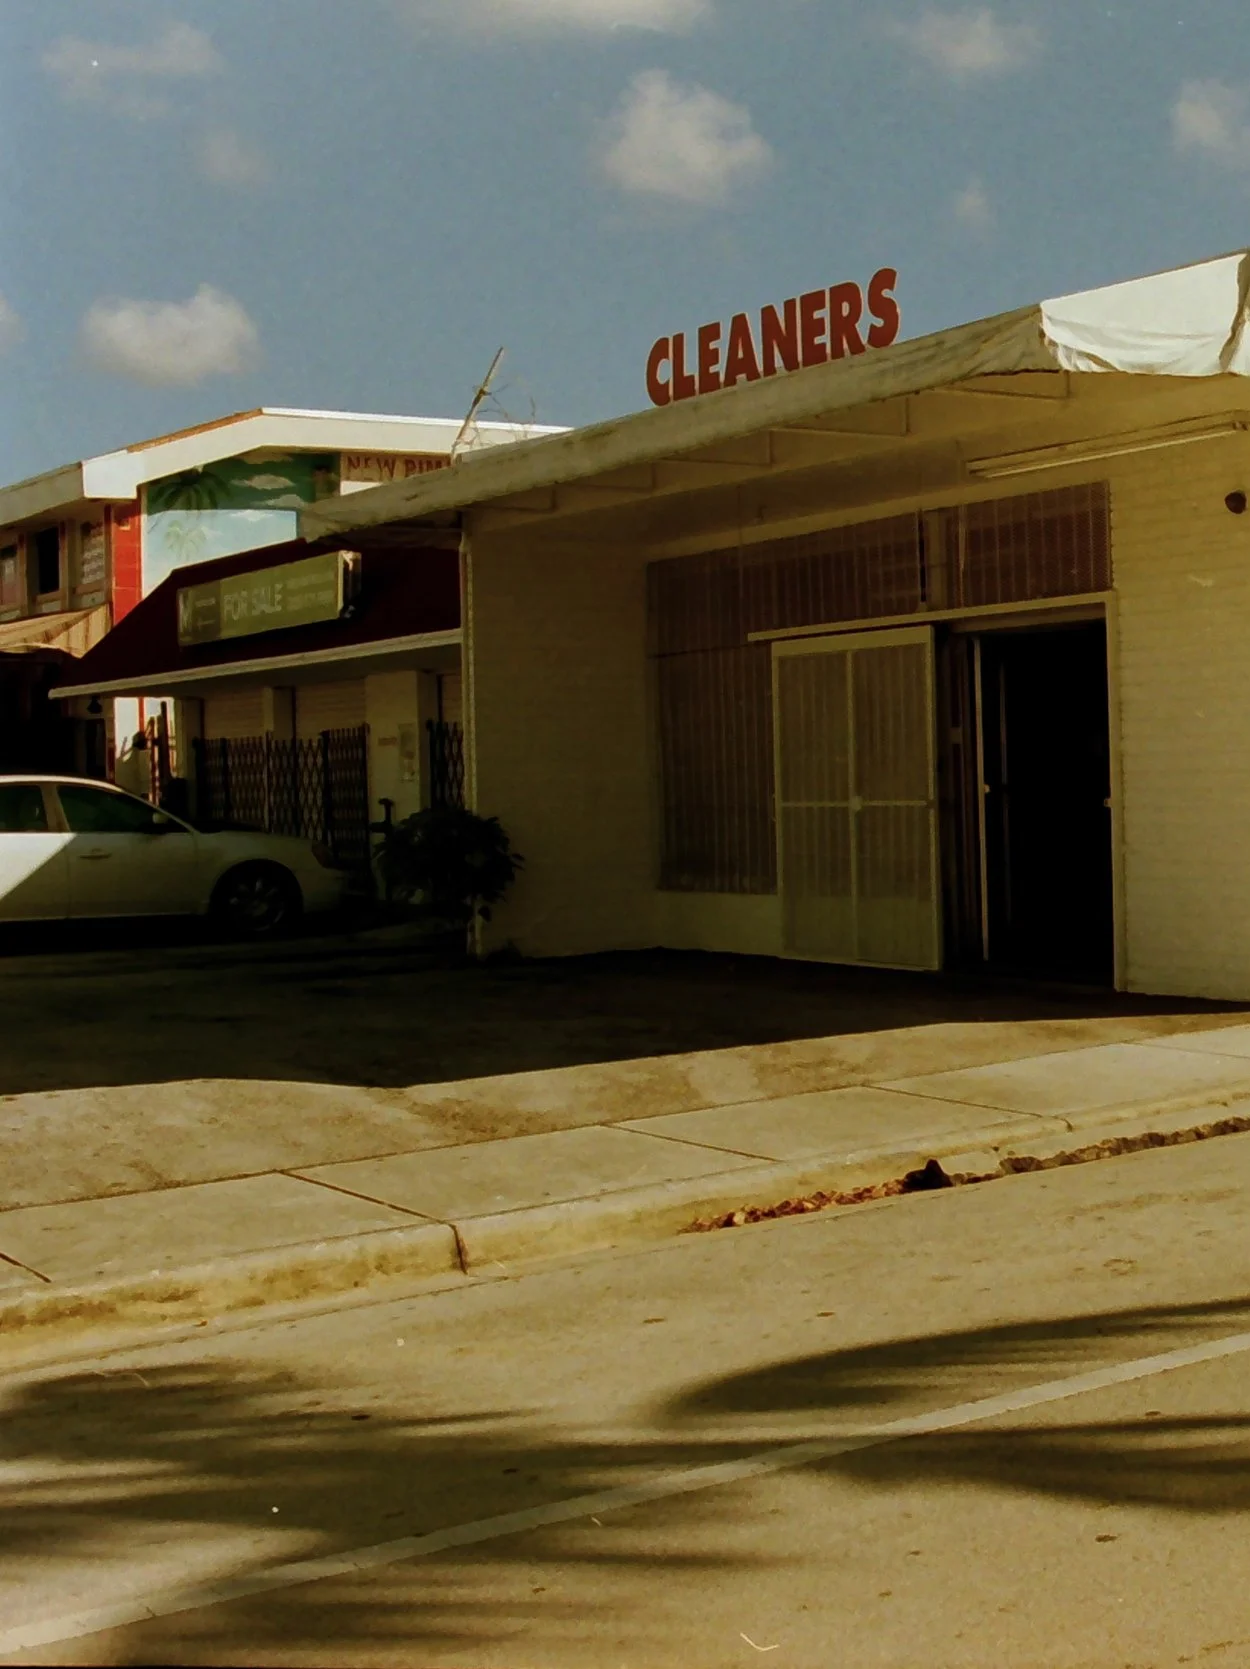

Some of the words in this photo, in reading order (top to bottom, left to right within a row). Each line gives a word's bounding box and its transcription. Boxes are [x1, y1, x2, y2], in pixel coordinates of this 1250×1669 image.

[645, 267, 900, 406] CLEANERS
[346, 456, 396, 481] NEW
[224, 589, 248, 621] FOR
[251, 583, 283, 616] SALE
